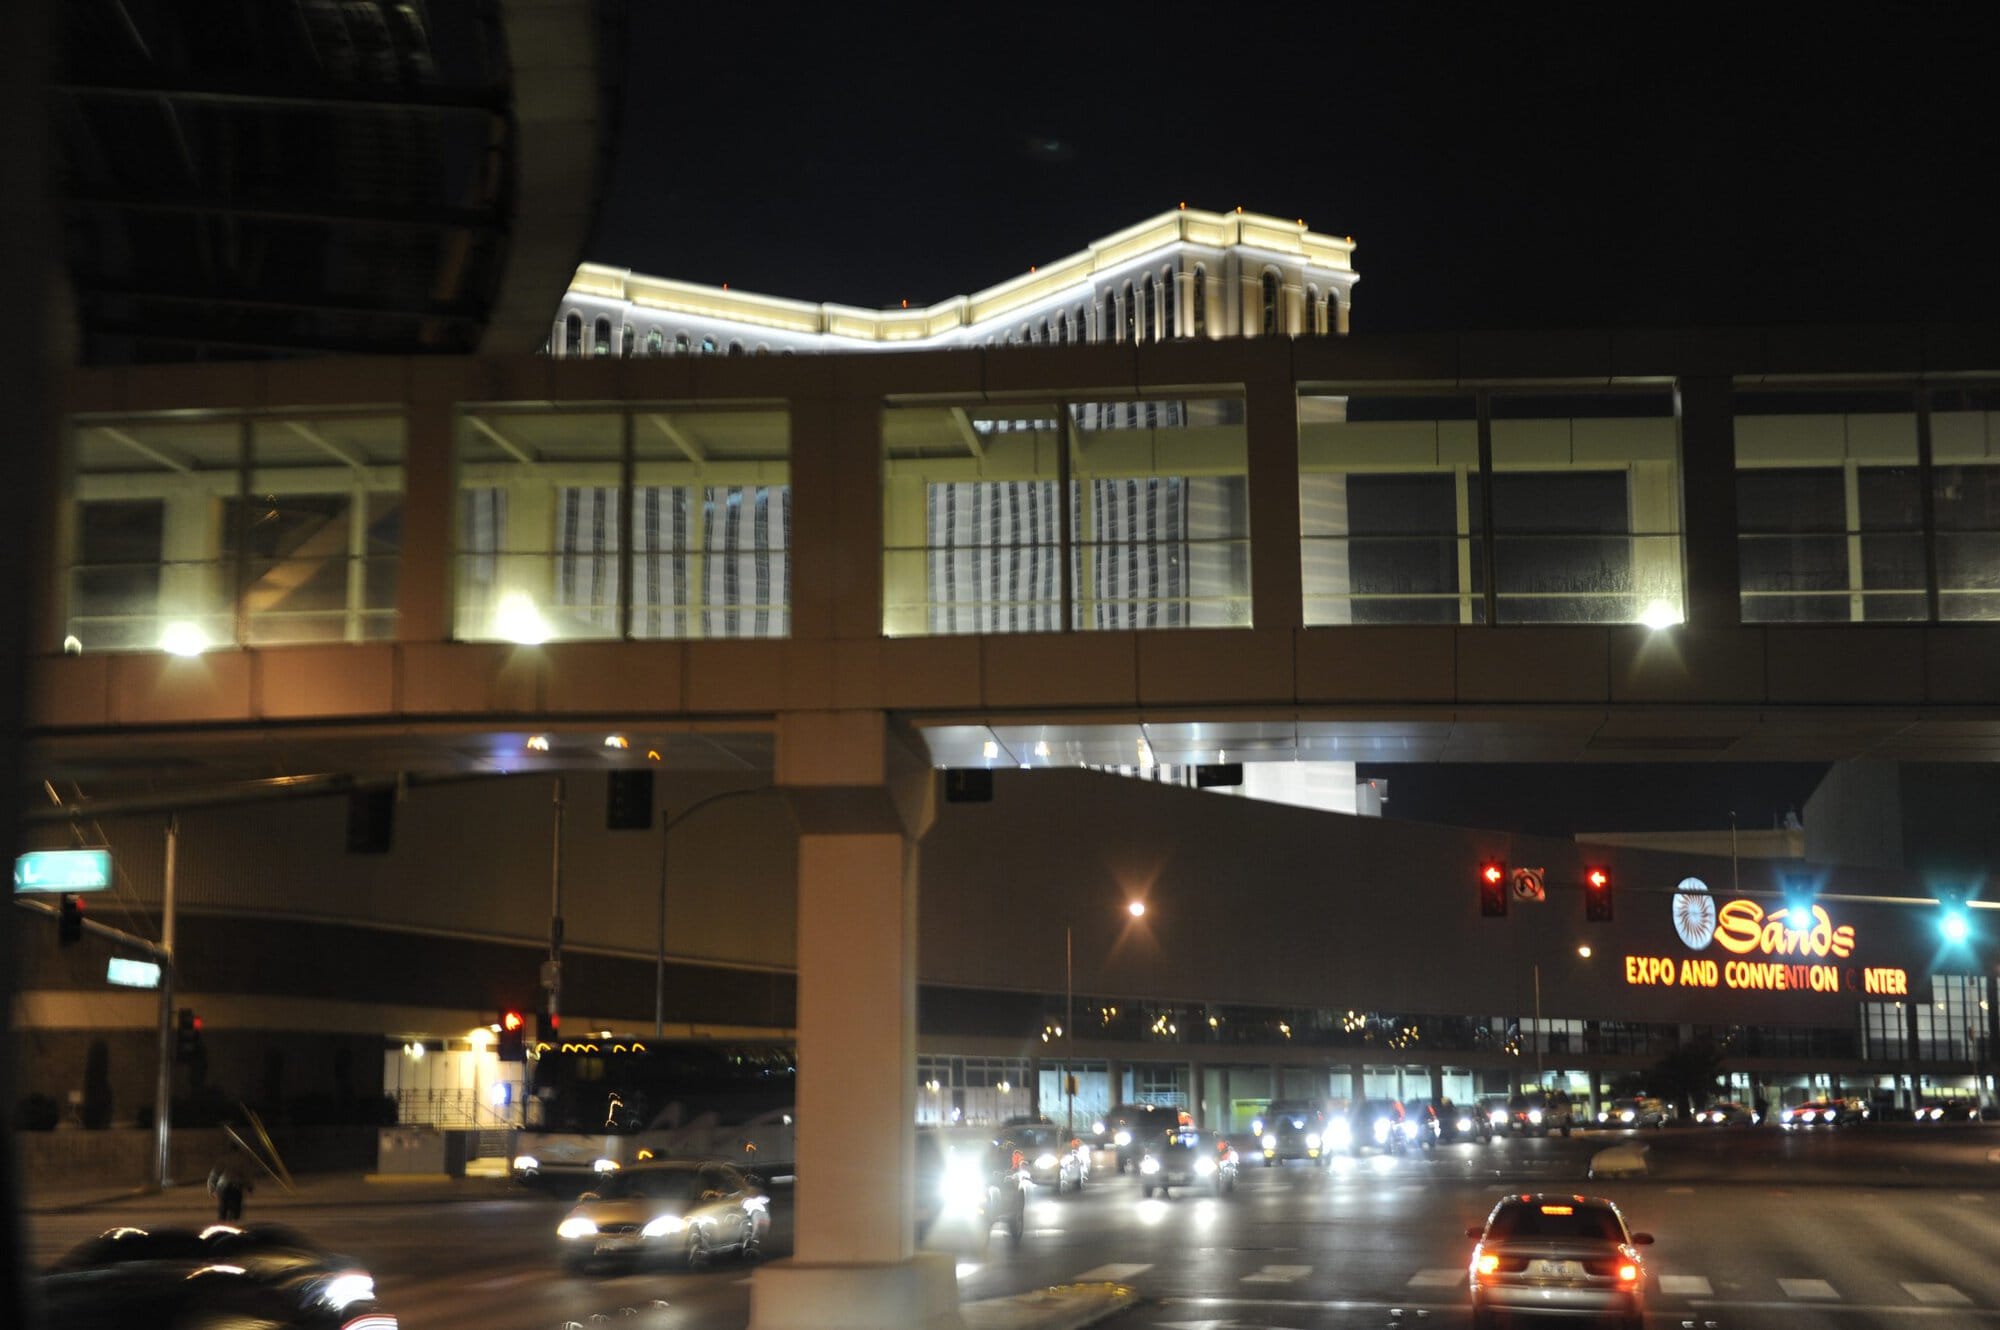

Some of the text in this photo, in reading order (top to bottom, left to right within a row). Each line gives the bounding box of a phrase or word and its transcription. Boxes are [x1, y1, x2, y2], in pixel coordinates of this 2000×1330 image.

[1713, 899, 1856, 958] Sands
[1625, 955, 1675, 987] EXPO
[1680, 960, 1718, 988] AND
[1725, 961, 1839, 993] CONVENTION
